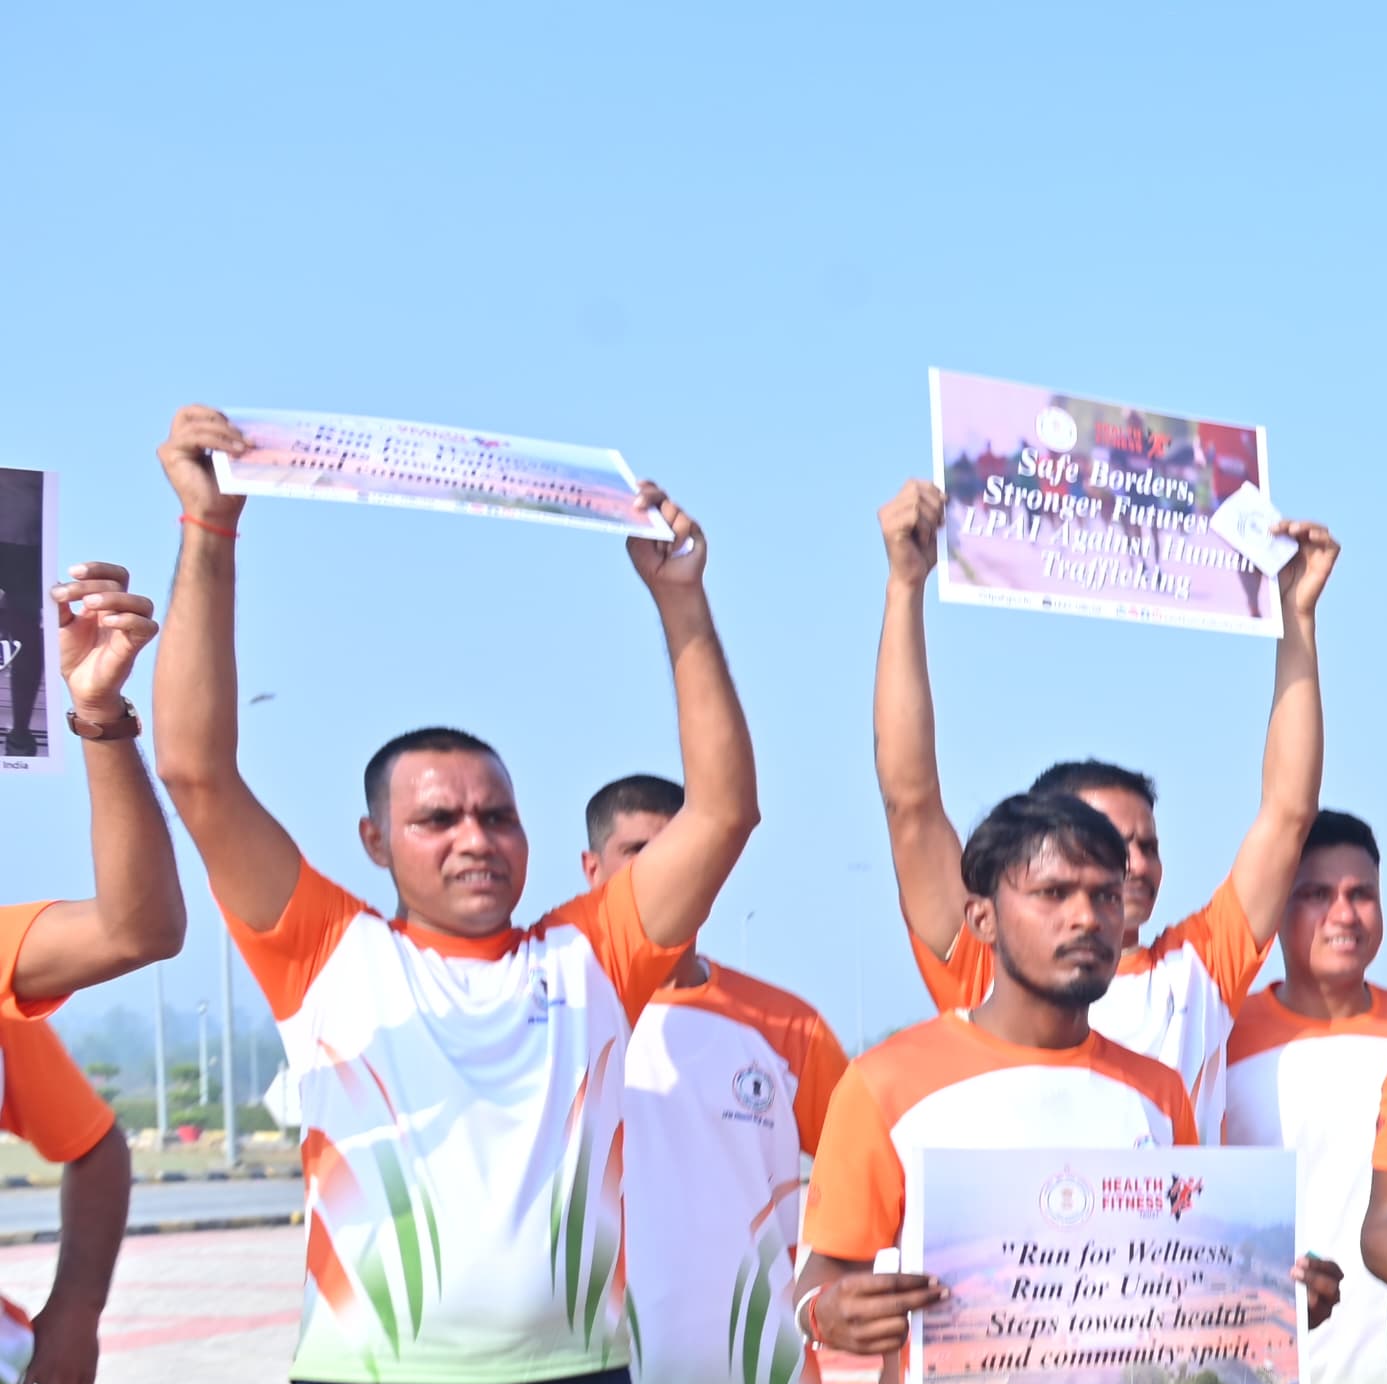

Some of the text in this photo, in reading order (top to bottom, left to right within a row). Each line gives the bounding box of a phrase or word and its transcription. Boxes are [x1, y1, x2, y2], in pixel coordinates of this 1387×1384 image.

[1019, 448, 1195, 506] Safe Borders,
[984, 476, 1102, 520] Stronger
[962, 507, 1041, 542] LPAI
[1050, 518, 1153, 554] Against
[1040, 549, 1192, 600] Trafficking
[1102, 1177, 1163, 1192] HEALTH
[1102, 1196, 1163, 1211] FITNESS
[1002, 1239, 1234, 1271] "Run for Wellness,
[1011, 1272, 1203, 1306] Run for Unity"
[986, 1305, 1247, 1339] Steps towards health
[981, 1341, 1257, 1372] and community spirit.
